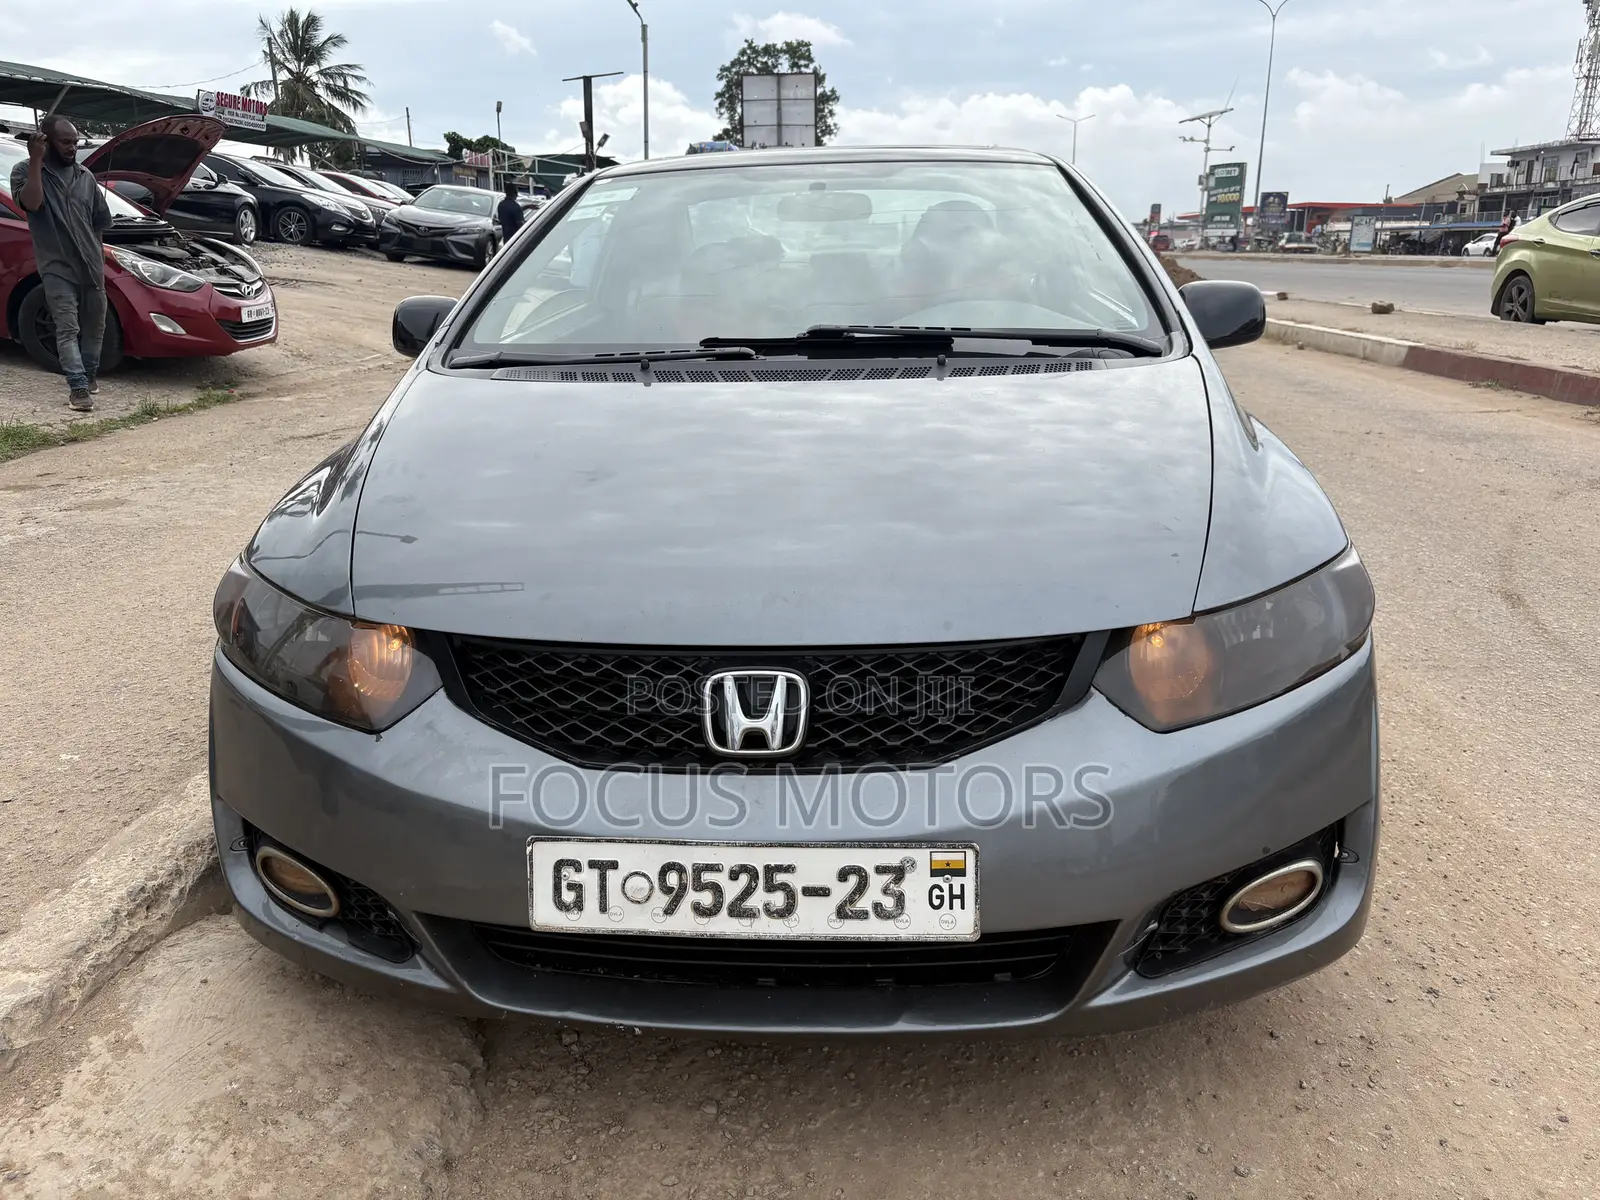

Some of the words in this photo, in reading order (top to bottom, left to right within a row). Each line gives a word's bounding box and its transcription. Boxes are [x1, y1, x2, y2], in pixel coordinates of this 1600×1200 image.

[216, 91, 240, 110] SECURE
[242, 96, 268, 116] MOTORS
[552, 858, 620, 914] GT
[657, 859, 907, 921] 9525-23
[927, 883, 967, 911] GH
